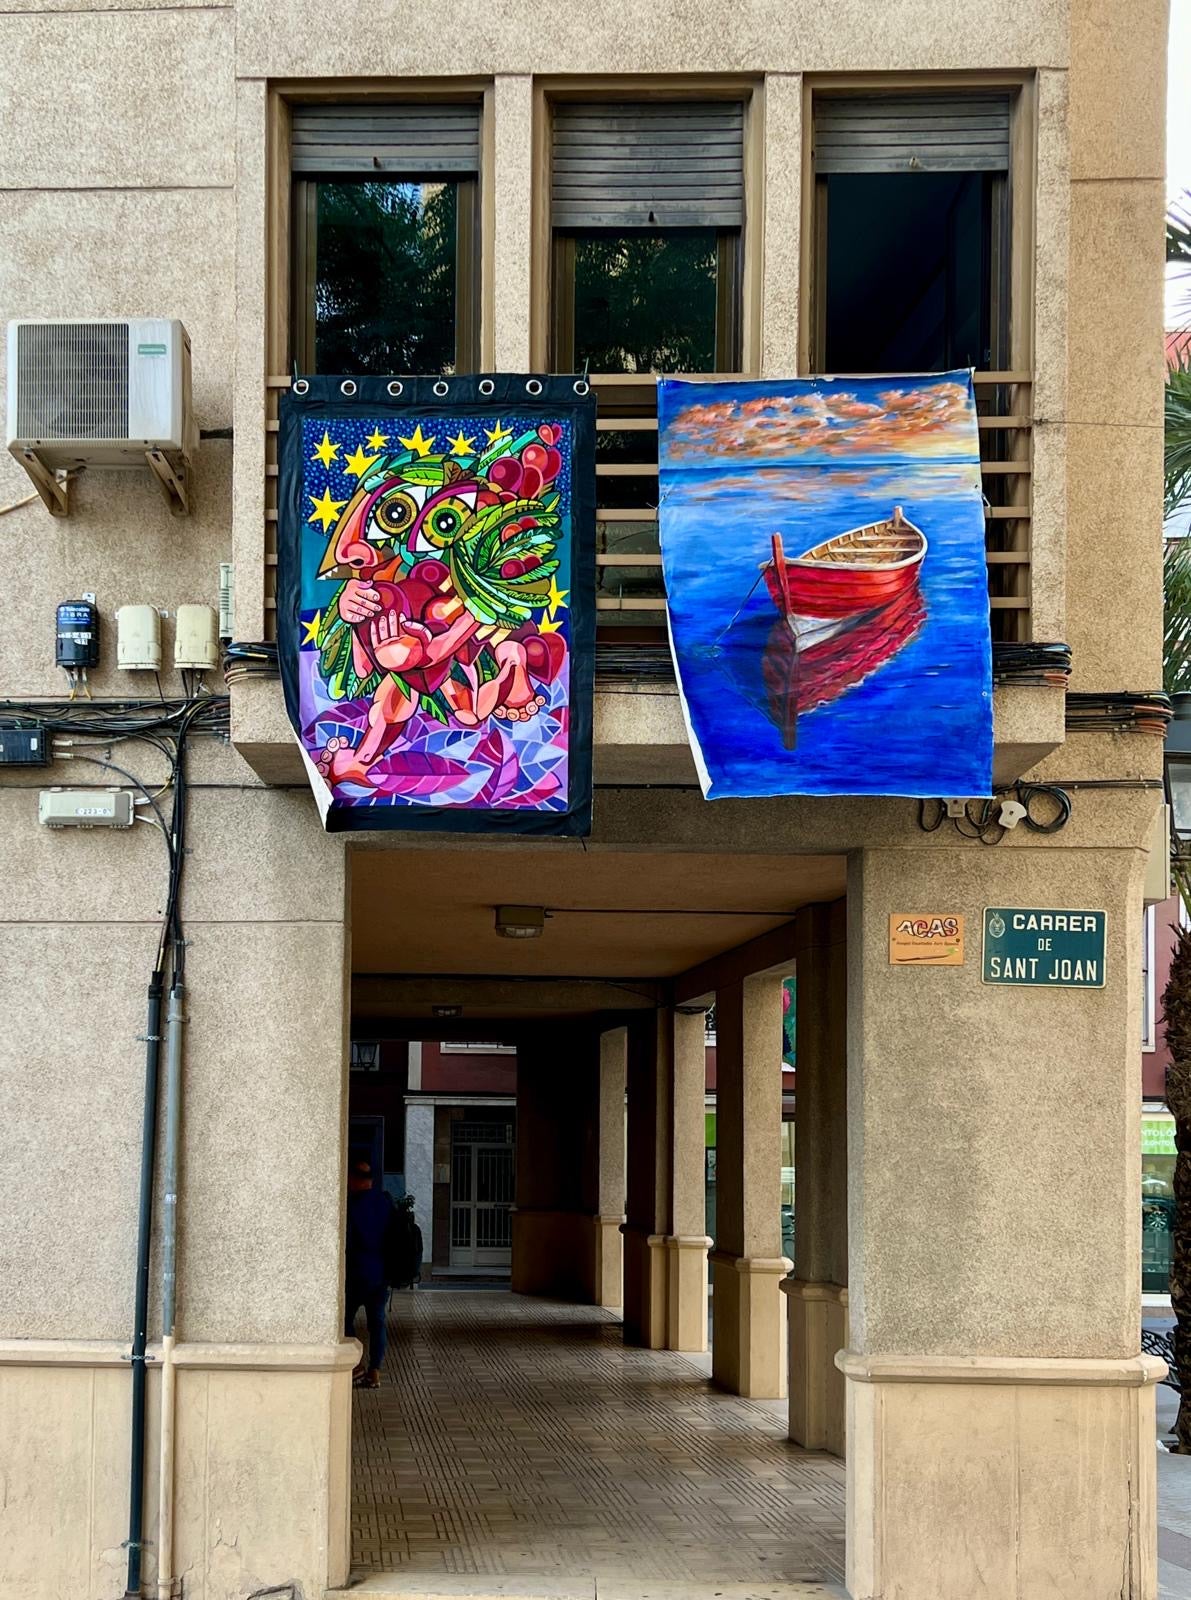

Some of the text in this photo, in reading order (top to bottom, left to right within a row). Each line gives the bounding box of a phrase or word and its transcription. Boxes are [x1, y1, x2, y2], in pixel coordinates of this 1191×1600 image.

[896, 917, 959, 938] ACAS
[1013, 914, 1097, 932] CARRER
[1038, 938, 1053, 951] DE
[990, 957, 1097, 981] SANT JOAN
